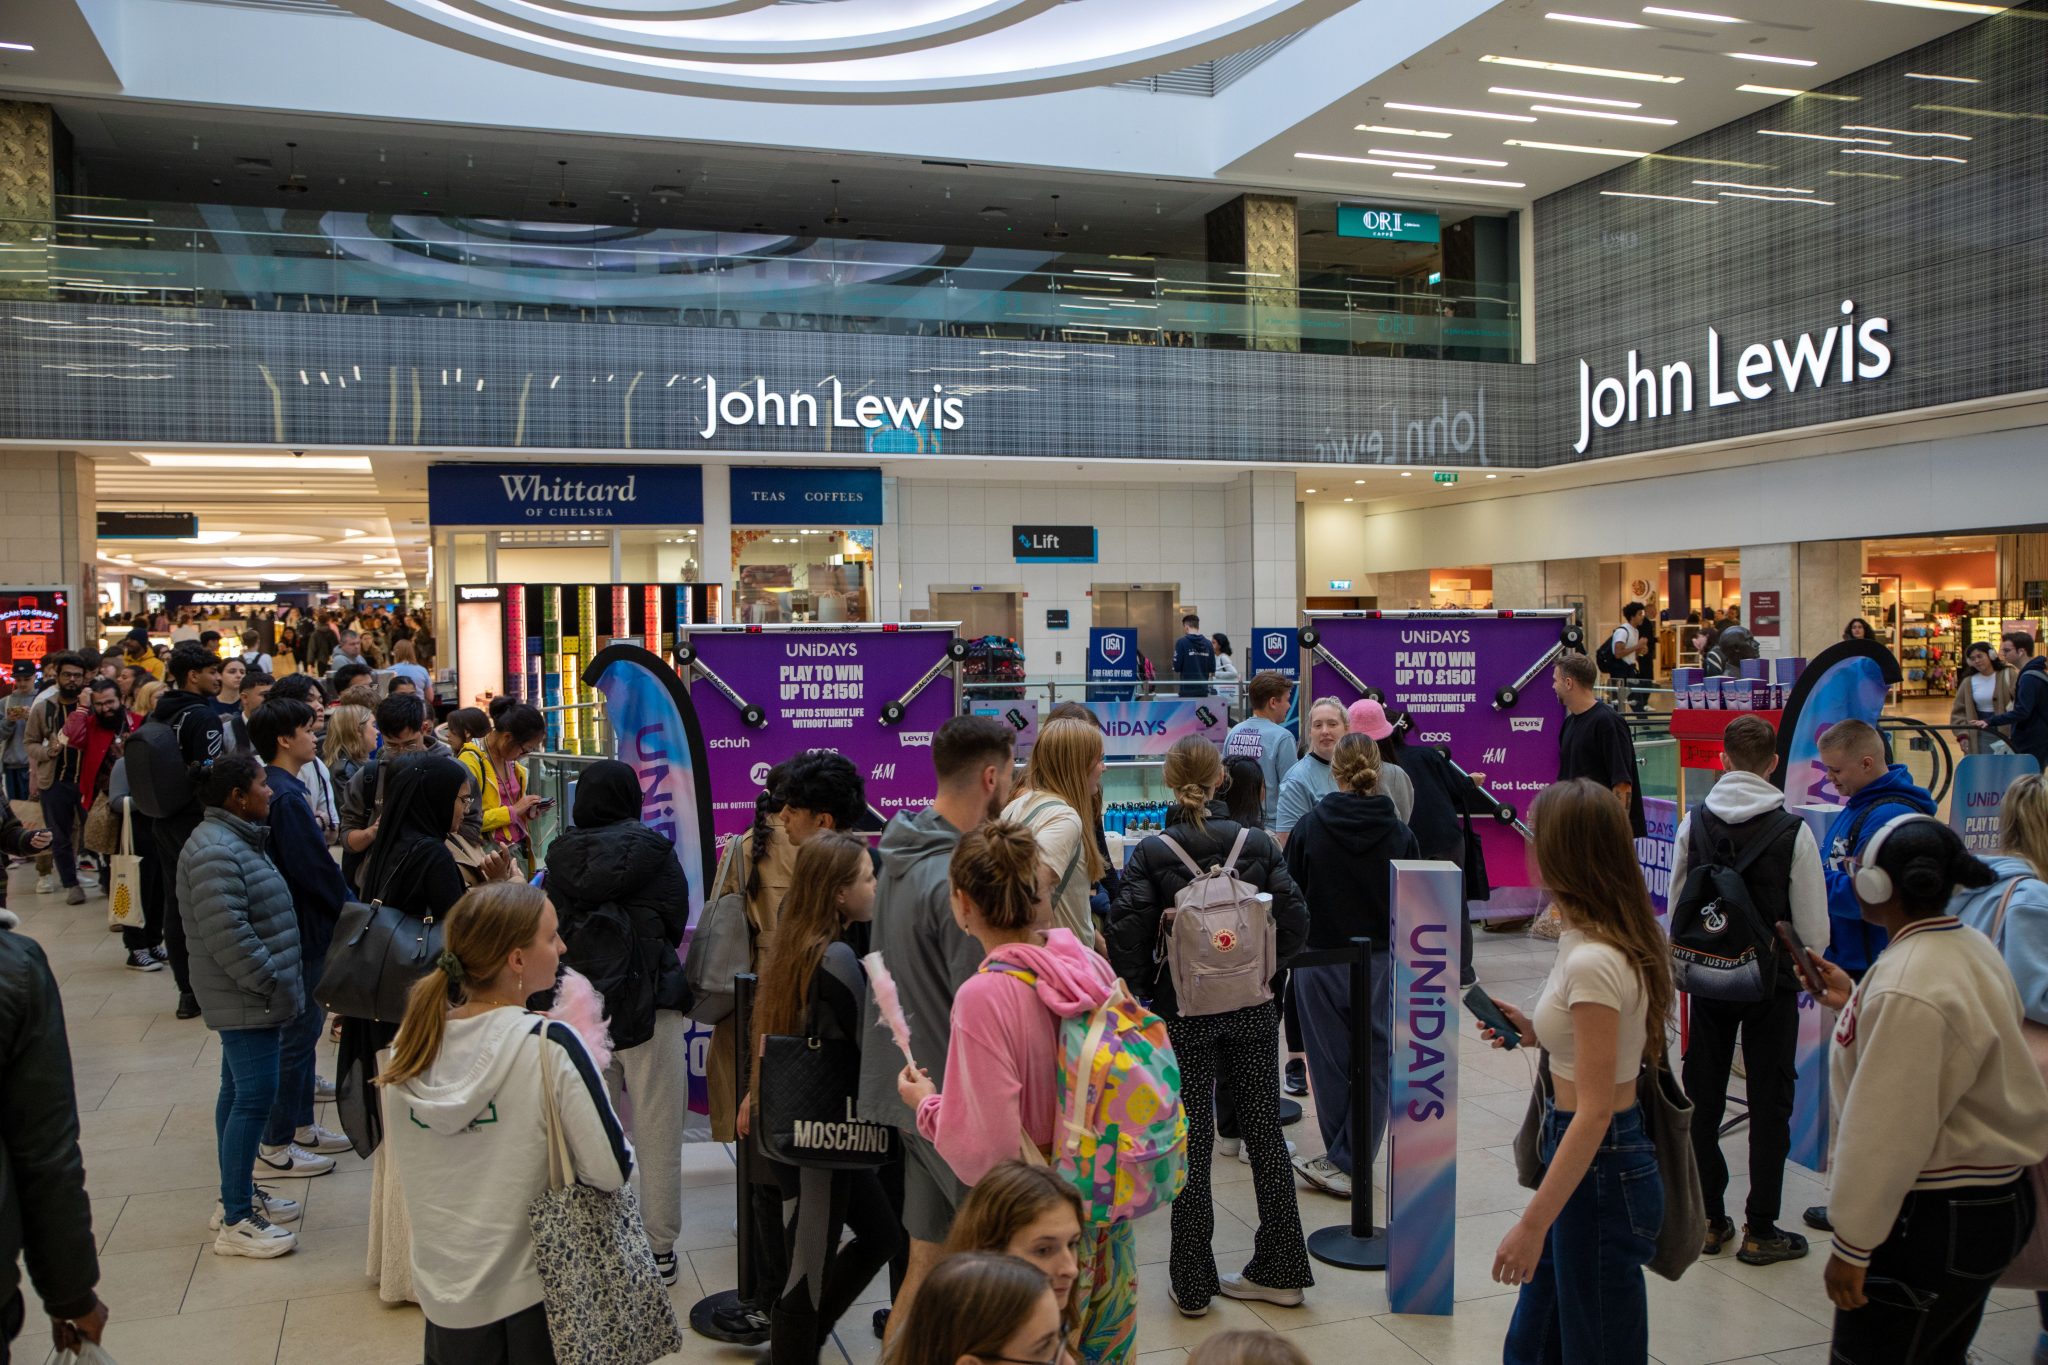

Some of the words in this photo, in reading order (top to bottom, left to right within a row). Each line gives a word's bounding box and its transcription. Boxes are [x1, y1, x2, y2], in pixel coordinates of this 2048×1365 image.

[1363, 211, 1403, 231] ORI
[1573, 350, 1693, 454] John
[1709, 300, 1891, 407] Lewis
[700, 374, 817, 439] John
[834, 378, 965, 430] Lewis
[499, 474, 637, 501] Whittard
[751, 491, 786, 501] TEAS
[804, 492, 864, 502] COFFEES
[525, 508, 543, 517] OF
[549, 508, 613, 517] CHELSEA
[1033, 534, 1060, 549] Lift
[5, 620, 55, 635] FREE
[1105, 637, 1120, 650] USA
[1267, 637, 1283, 650] USA
[1401, 630, 1471, 644] UNiDAYS
[786, 643, 858, 657] UNiDAYS
[1395, 651, 1427, 668] PLAY
[1428, 651, 1447, 668] TO
[1447, 651, 1476, 668] WIN
[780, 665, 814, 682] PLAY
[815, 665, 834, 681] TO
[834, 664, 864, 681] WIN
[911, 666, 940, 695] REACTION
[1395, 669, 1415, 686] UP
[1416, 669, 1434, 685] TO
[1435, 669, 1476, 685] £150!
[705, 671, 737, 700] REACTION
[780, 683, 800, 700] UP
[801, 683, 820, 700] TO
[822, 683, 864, 700] £150!
[1396, 693, 1410, 702] TAP
[1410, 693, 1427, 702] INTO
[1428, 693, 1460, 702] STUDENT
[1461, 693, 1476, 702] LIFE
[781, 708, 796, 718] TAP
[796, 708, 814, 718] INTO
[814, 708, 848, 718] STUDENT
[848, 707, 864, 717] LIFE
[1407, 703, 1440, 713] WITHOUT
[1441, 703, 1465, 713] LIMITS
[792, 719, 827, 728] WITHOUT
[828, 718, 853, 728] LIMITS
[709, 736, 750, 749] schuh
[1232, 734, 1261, 746] STUDENT
[1420, 732, 1451, 742] asos
[1491, 780, 1513, 791] Foot
[880, 797, 903, 808] Foot
[1967, 791, 2004, 808] UNiD
[1965, 817, 1987, 832] PLAY
[1978, 833, 1990, 849] TO
[1407, 924, 1448, 1123] UNiDAYS
[793, 1119, 889, 1153] MOSCHINO
